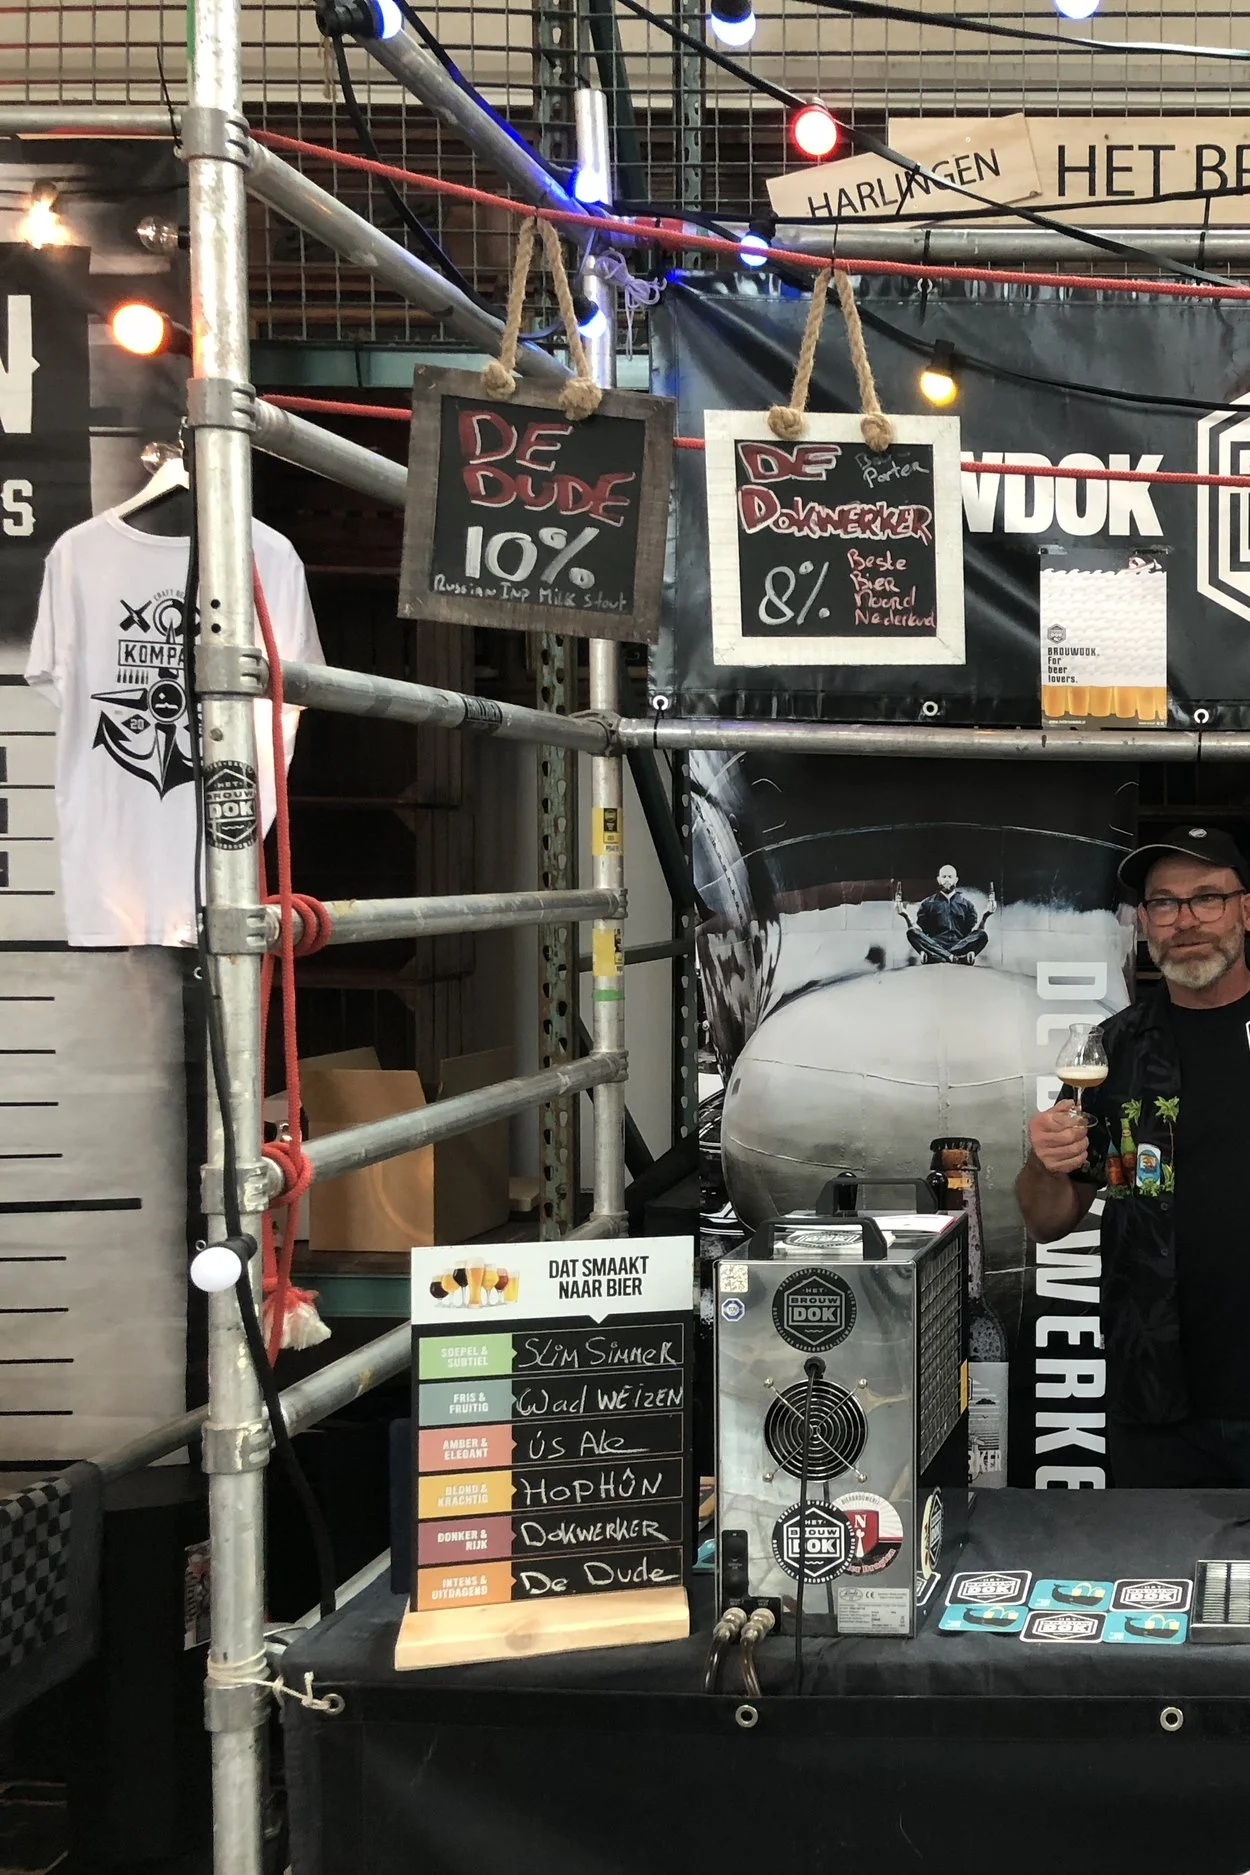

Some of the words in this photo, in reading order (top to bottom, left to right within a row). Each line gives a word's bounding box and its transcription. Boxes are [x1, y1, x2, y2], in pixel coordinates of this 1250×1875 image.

[1057, 144, 1176, 198] HET
[807, 148, 1001, 217] HARLINGEN
[458, 410, 574, 471] DE
[737, 442, 841, 483] DE
[463, 465, 635, 527] DUDE
[465, 526, 600, 589] 10%
[847, 548, 907, 571] Beste
[758, 560, 831, 626] 8%
[1048, 665, 1068, 674] beer
[1048, 674, 1078, 683] lovers.
[129, 718, 145, 731] 20
[208, 801, 254, 819] DOK
[549, 1259, 579, 1279] DAT
[582, 1255, 650, 1277] SMAAKT
[559, 1279, 602, 1299] NAAR
[606, 1277, 642, 1297] BIER
[793, 1307, 836, 1321] DOK
[441, 1346, 478, 1358] SOEPEL
[447, 1356, 489, 1368] SUBTIEL
[453, 1392, 476, 1404] FRIS
[516, 1384, 588, 1416] Wad
[449, 1402, 489, 1414] FRUITIG
[442, 1438, 478, 1450] AMBER
[444, 1447, 489, 1460] ELEGANT
[854, 1514, 868, 1529] N
[437, 1529, 478, 1543] DONKER
[465, 1540, 488, 1551] RIJK
[442, 1576, 478, 1588] INTENS
[520, 1571, 569, 1595] De
[583, 1556, 680, 1586] Dude
[431, 1585, 488, 1600] UITDAGEND
